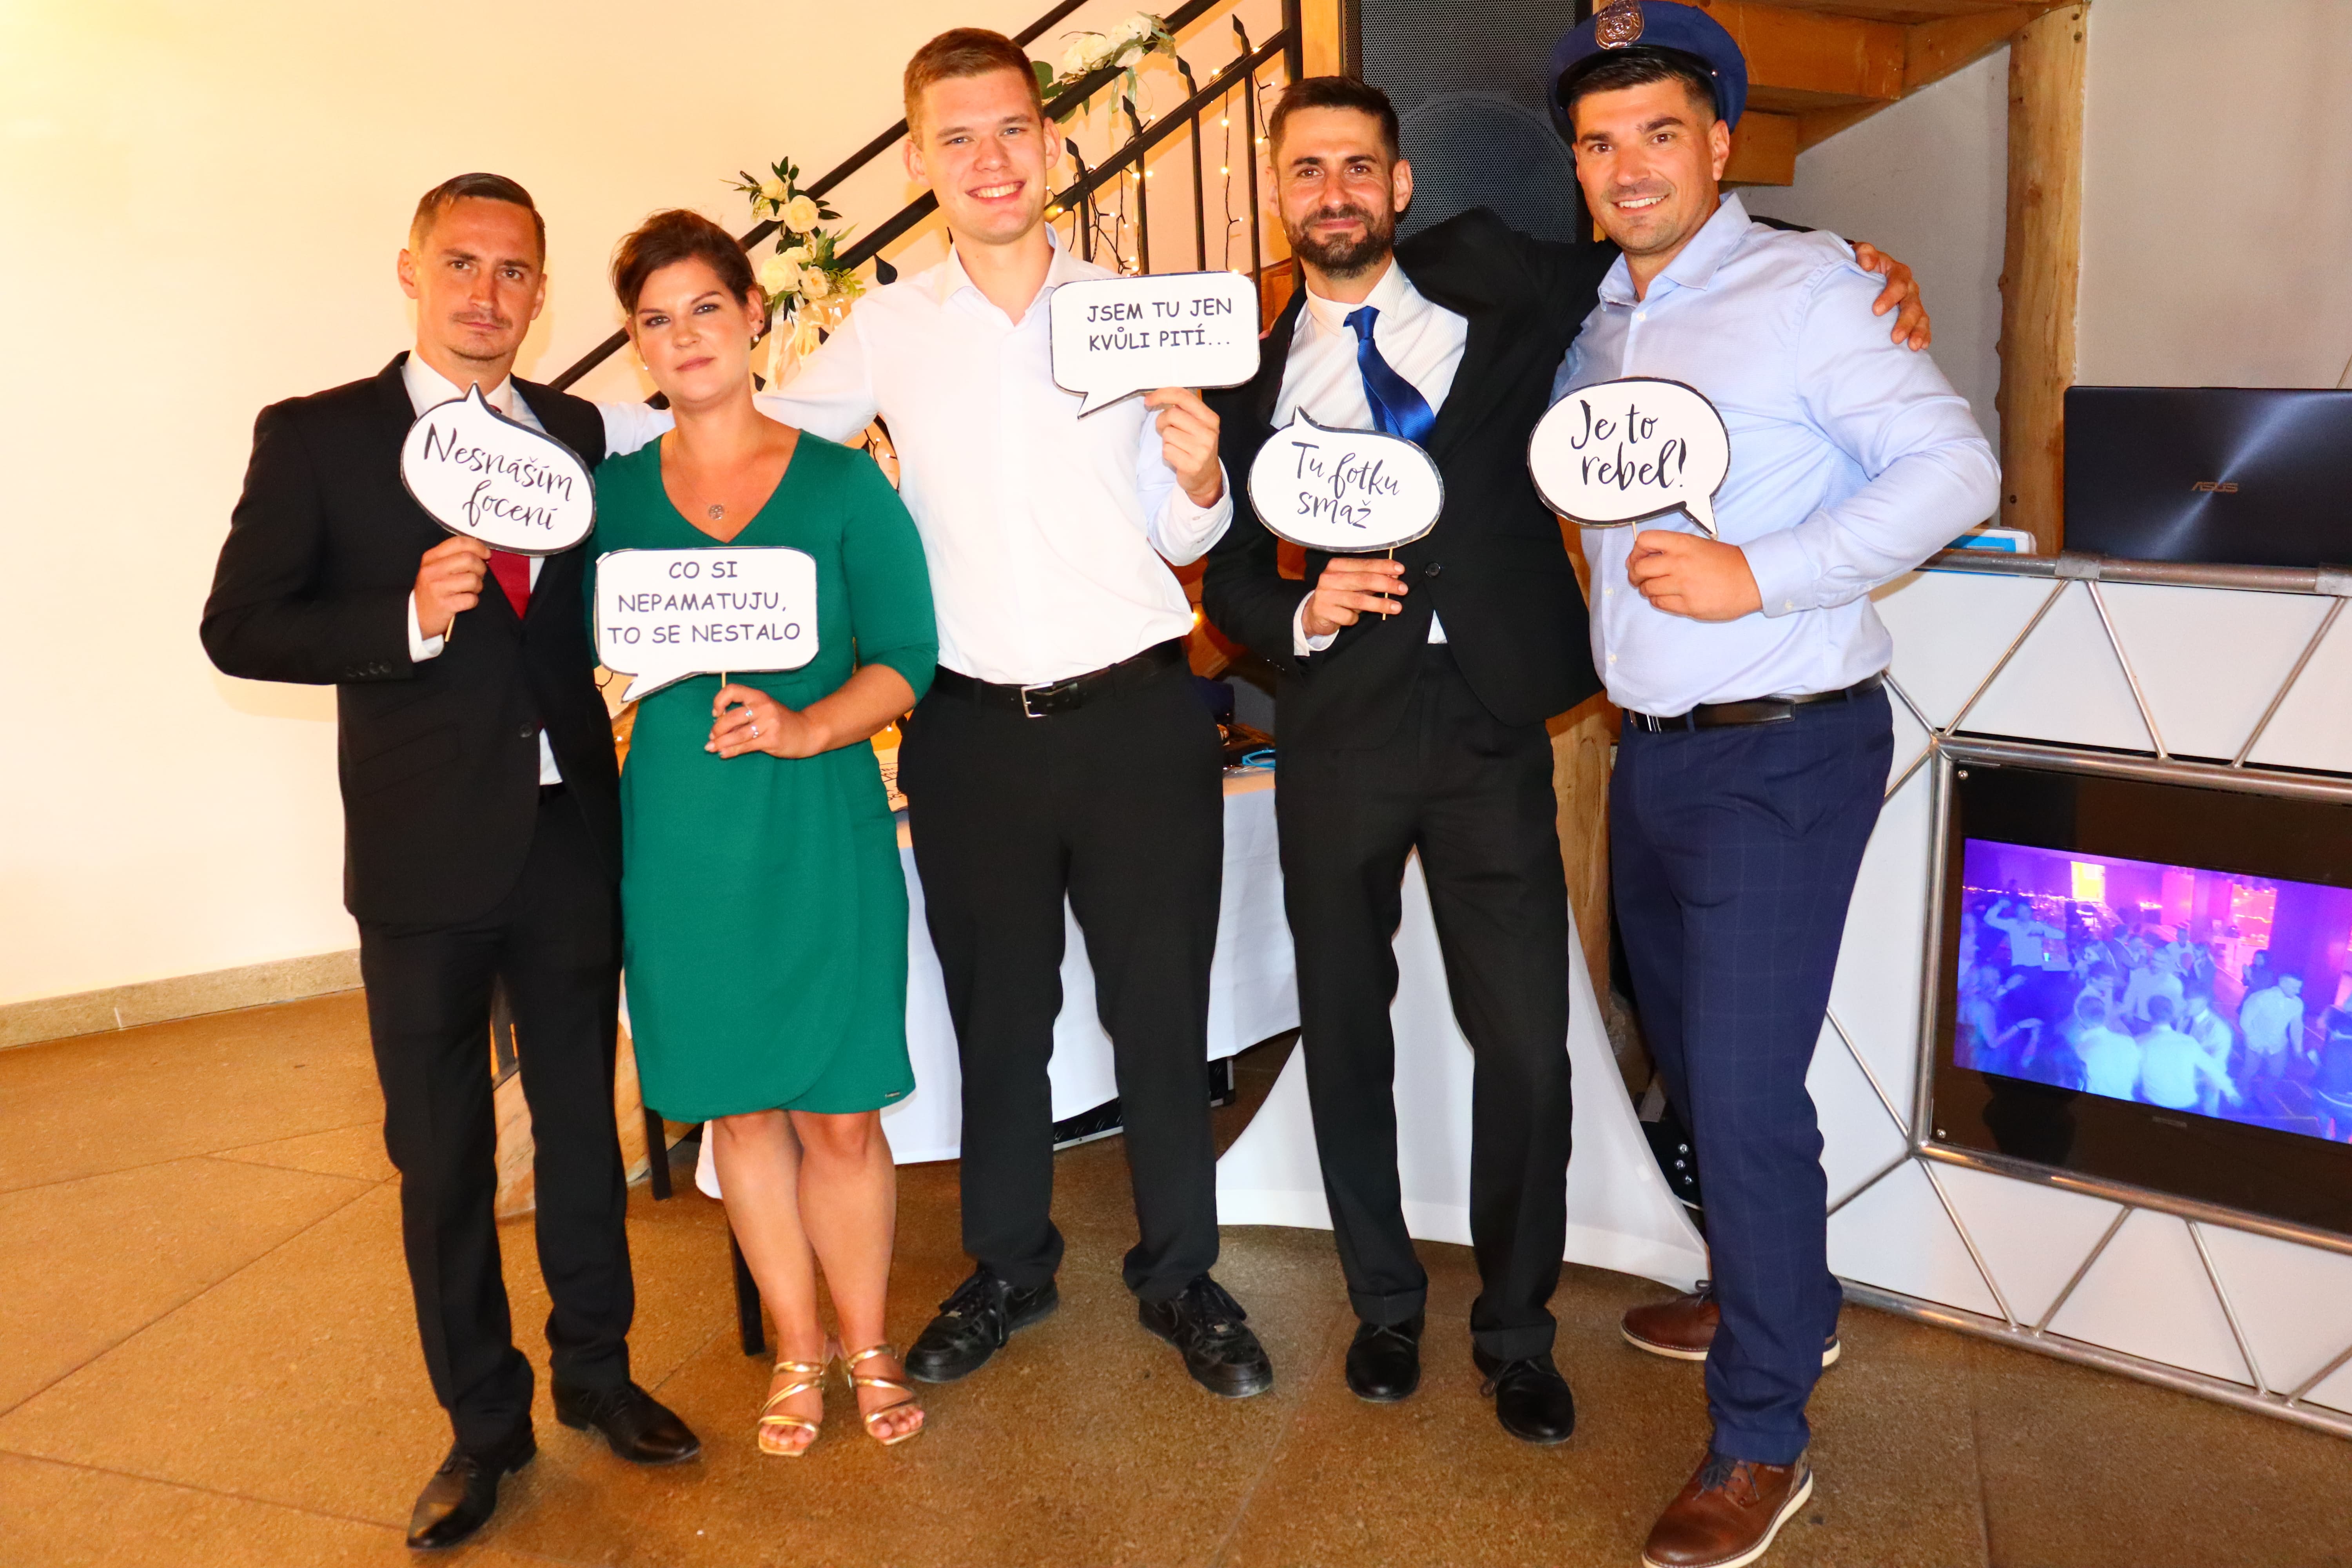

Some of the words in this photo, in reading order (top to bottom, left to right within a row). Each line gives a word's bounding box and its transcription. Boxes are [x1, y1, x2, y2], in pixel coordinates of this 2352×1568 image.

[1087, 303, 1143, 322] JSEM
[1152, 301, 1180, 318] TU
[1190, 298, 1231, 317] JEN
[1089, 326, 1150, 352] KVŮLI
[1160, 323, 1230, 347] PITÍ...
[1571, 399, 1616, 450] Je
[1625, 403, 1659, 444] to
[424, 422, 572, 501] Nesnáším
[1291, 441, 1324, 479] Tu
[1328, 452, 1399, 499] fotku
[1582, 437, 1686, 491] rebel!
[2191, 481, 2238, 492] ASUS
[462, 479, 558, 530] focení
[1297, 491, 1371, 529] smaž
[669, 561, 700, 579] CO
[711, 561, 738, 579] SI
[619, 592, 786, 612] NEPAMATUJU,
[607, 627, 641, 644] TO
[652, 624, 681, 644] SE
[692, 622, 800, 642] NESTALO
